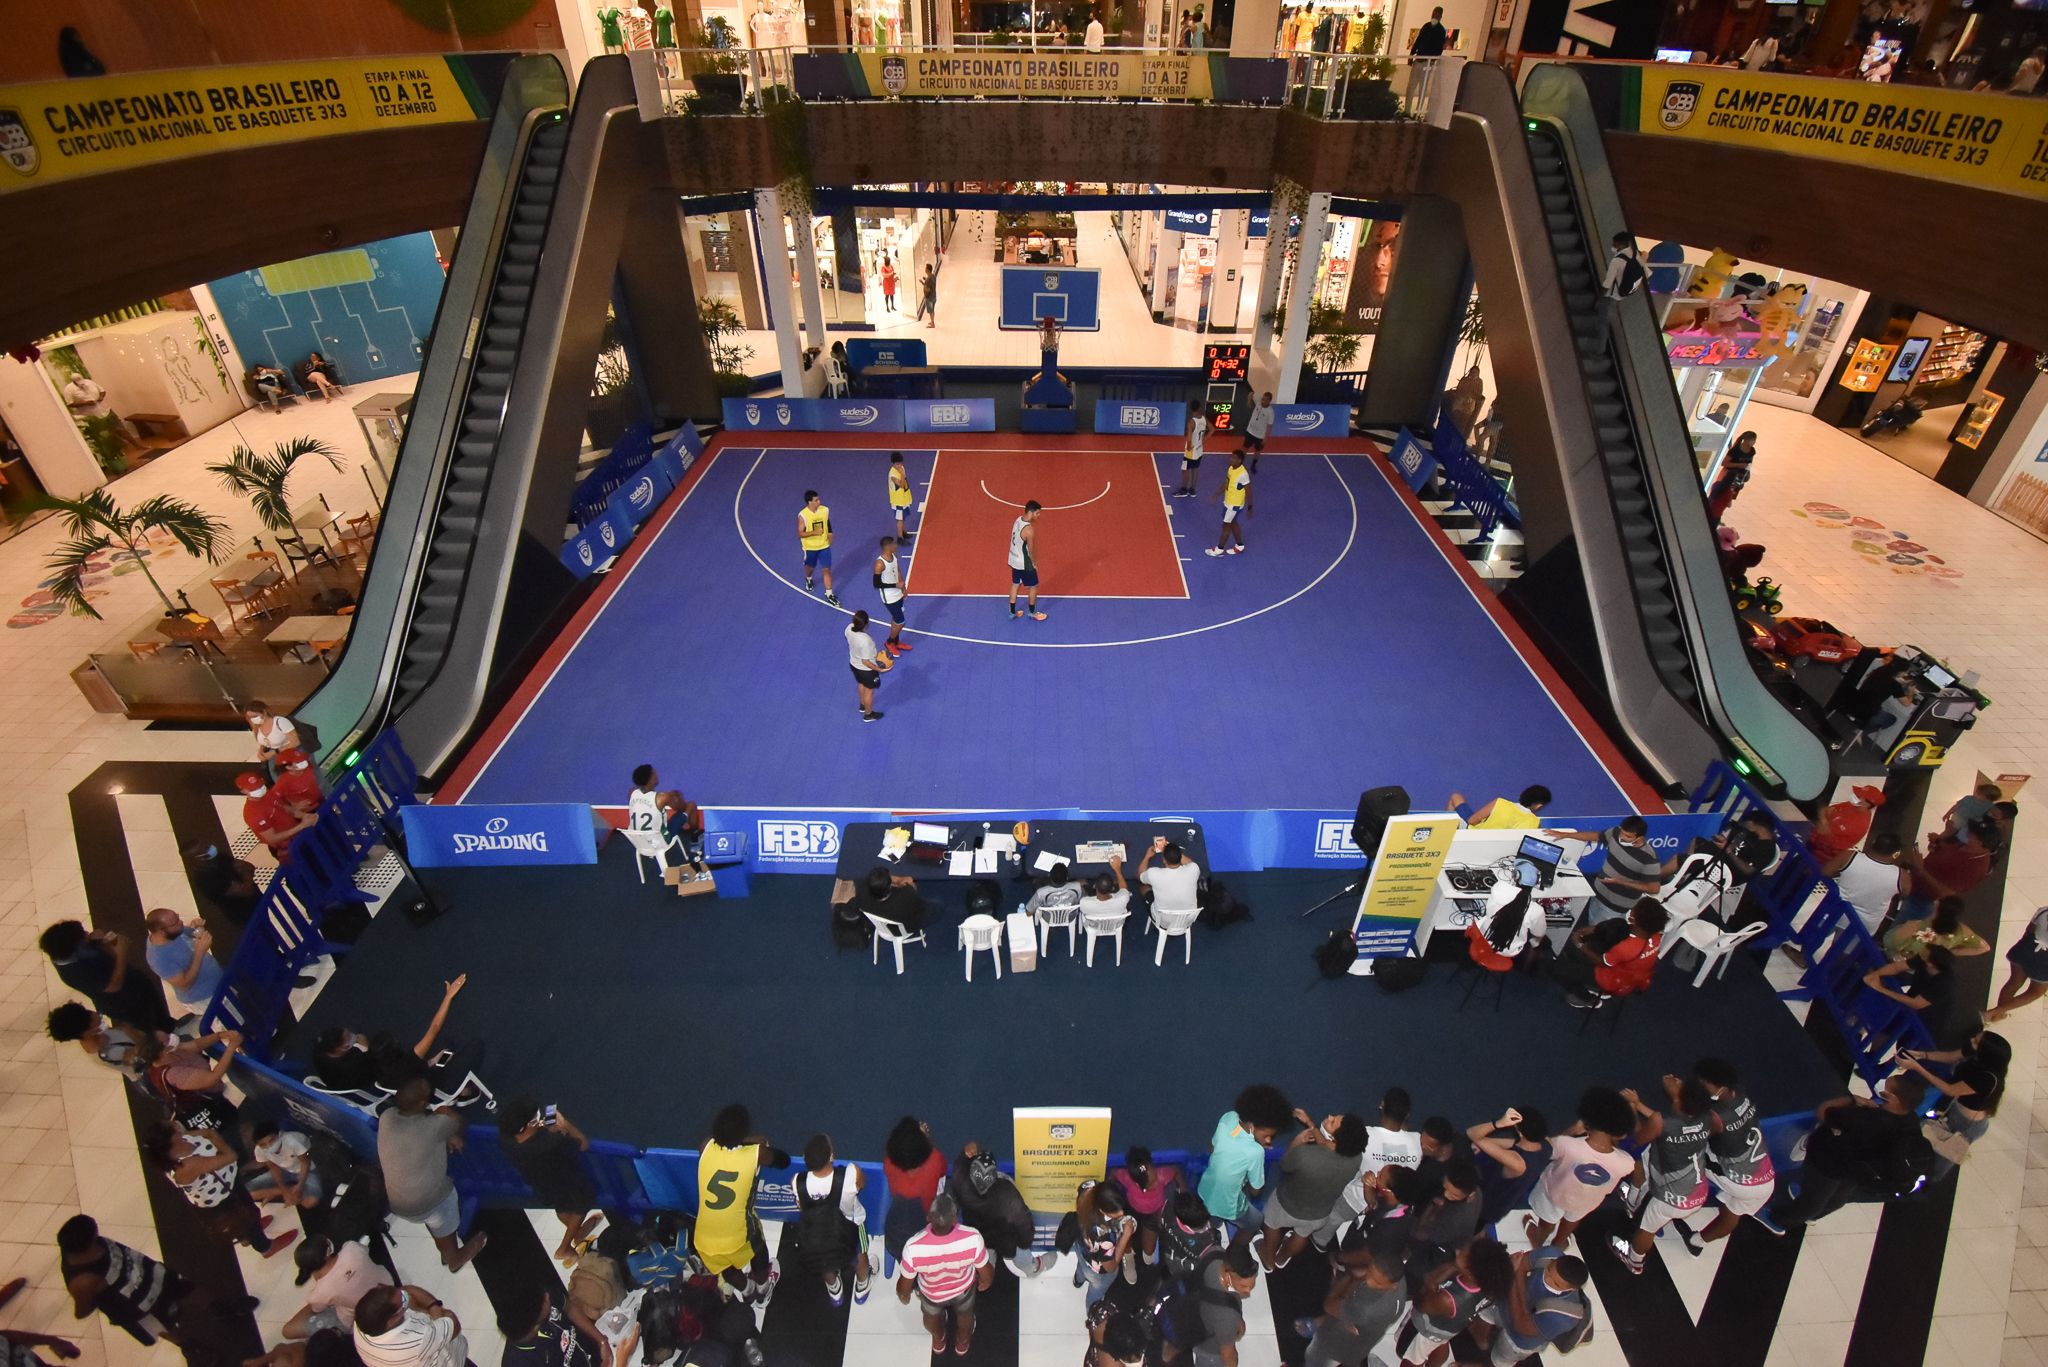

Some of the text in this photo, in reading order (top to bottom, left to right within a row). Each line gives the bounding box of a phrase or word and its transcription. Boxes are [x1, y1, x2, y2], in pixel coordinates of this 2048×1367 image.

[919, 59, 1119, 78] CAMPEONATO BRASILEIRO
[1143, 61, 1190, 69] ETAPA FINAL
[365, 69, 430, 83] ETAPA FINAL
[919, 78, 1118, 91] CIRCUITO NACIONAL DE BASQUETE 3X3
[1143, 71, 1188, 84] 10 A 12
[369, 82, 434, 103] 10 A 12
[1142, 86, 1186, 95] DEZEMBRO
[44, 78, 341, 134] CAMPEONATO BRASILEIRO
[376, 101, 438, 117] DEZEMBRO
[1714, 88, 2003, 145] CAMPEONATO BRASILEIRO
[58, 103, 347, 157] CIRCUITO NACIONAL DE BASQUETE 3X3
[1707, 112, 1770, 133] CIRCUITO
[1772, 117, 1843, 144] NACIONAL
[1850, 129, 1872, 147] DE
[1874, 133, 1953, 160] BASQUETE
[1953, 145, 1989, 166] 3X3
[1209, 347, 1217, 358] 0
[1240, 348, 1247, 358] 0
[1211, 369, 1245, 378] 10 4
[839, 407, 870, 417] sudesb
[1213, 404, 1232, 413] 4:32
[1215, 414, 1230, 428] 12
[1286, 413, 1316, 422] sudesb
[629, 481, 649, 503] sudesb
[631, 812, 653, 831] 12
[453, 832, 549, 854] SPALDING
[758, 820, 840, 857] FBB
[1386, 850, 1441, 859] BASQUETE 3X3
[1746, 1126, 1768, 1163] 2
[1687, 1152, 1702, 1185] 1
[705, 1169, 740, 1210] 5
